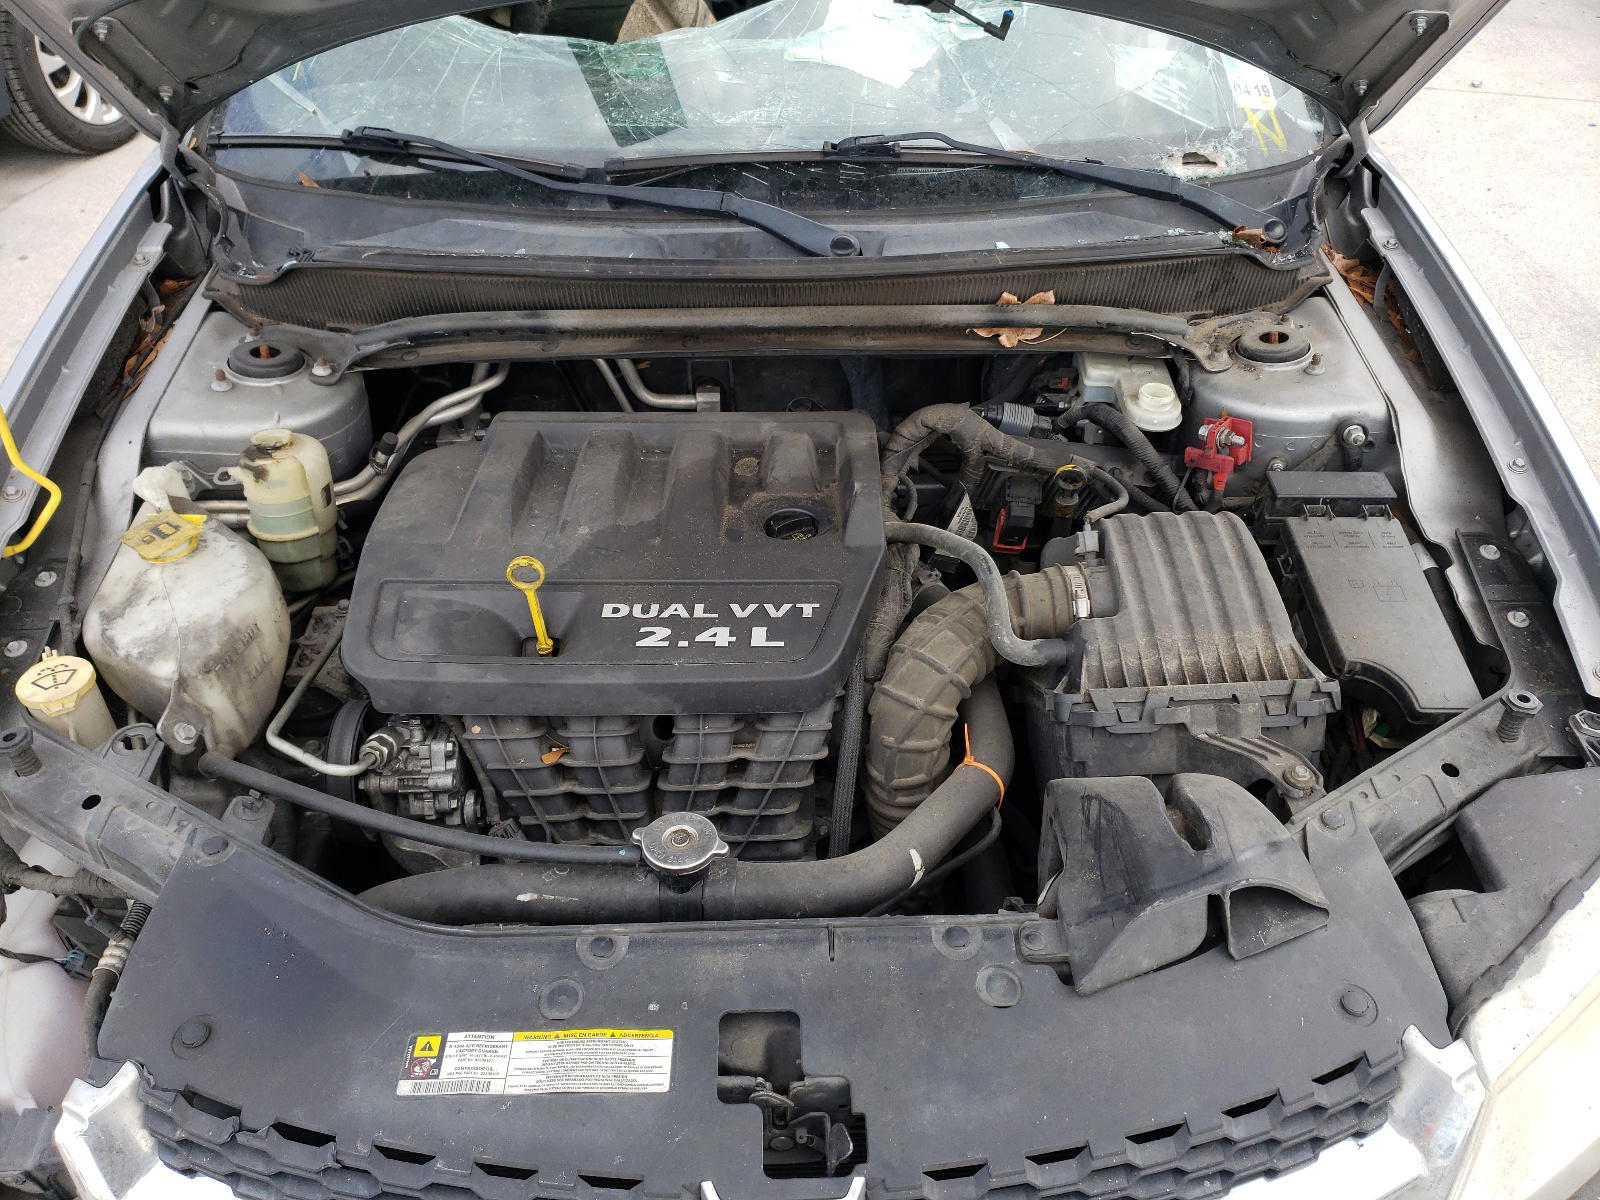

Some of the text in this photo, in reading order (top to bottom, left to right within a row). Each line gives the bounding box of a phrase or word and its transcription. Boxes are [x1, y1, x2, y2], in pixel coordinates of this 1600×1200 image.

[1254, 83, 1271, 97] 19
[601, 603, 820, 619] DUAL VVT
